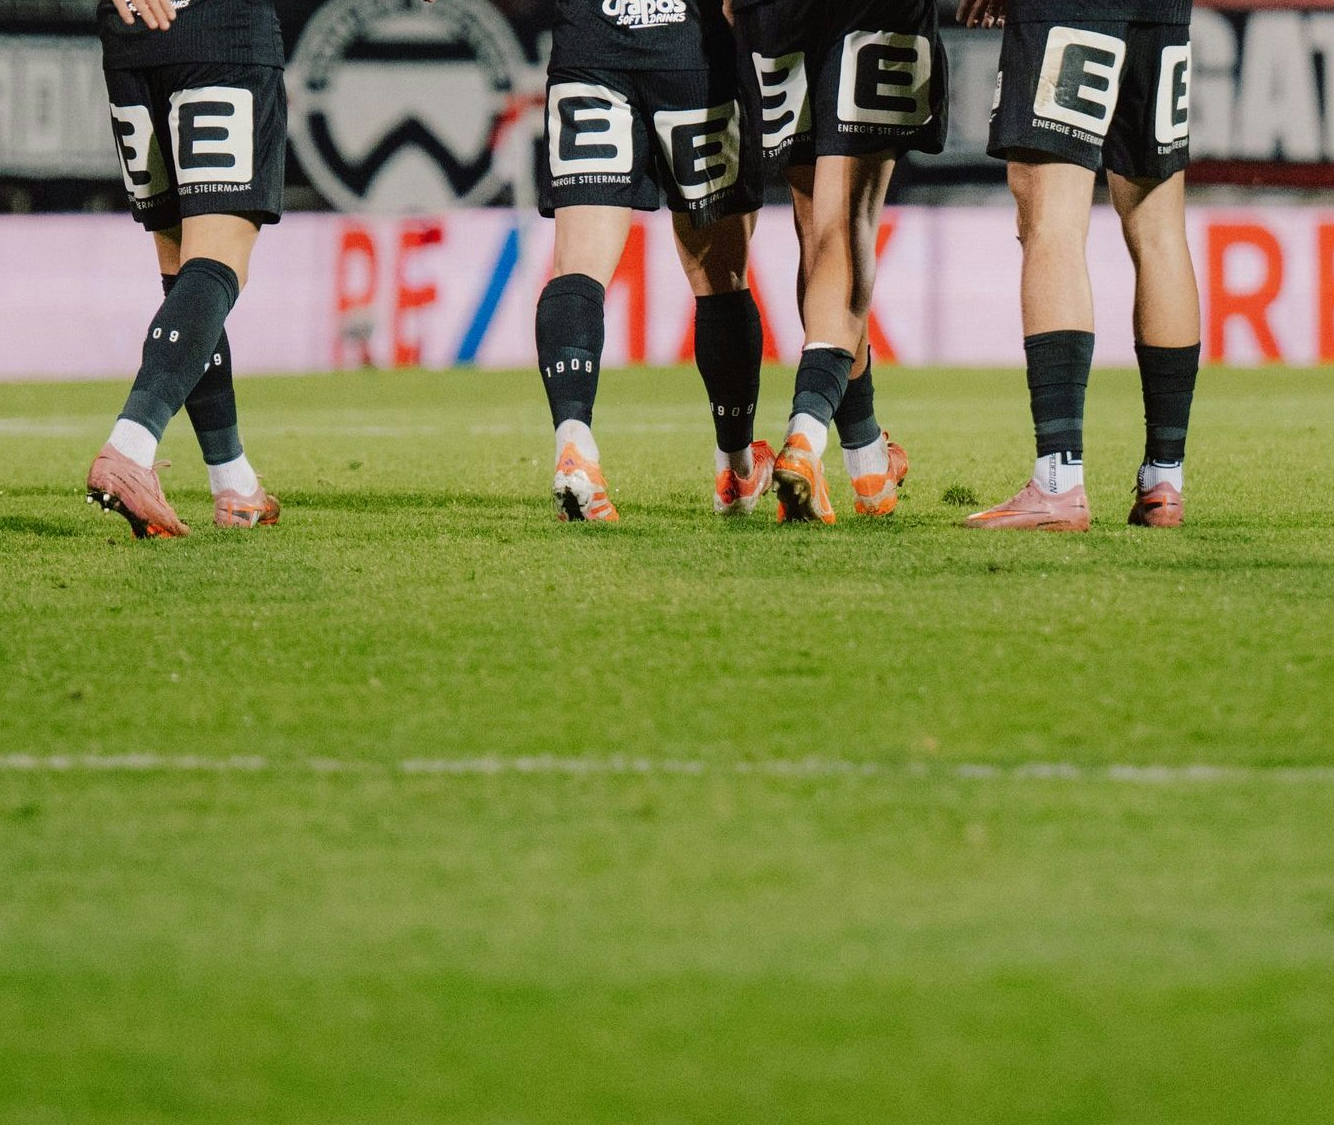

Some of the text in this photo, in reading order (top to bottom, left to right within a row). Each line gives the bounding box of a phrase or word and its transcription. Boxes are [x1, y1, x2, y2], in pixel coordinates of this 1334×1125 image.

[616, 13, 686, 25] SOFT DRINKS
[1032, 118, 1069, 135] ENERGIE
[579, 176, 632, 185] STEIERMARK
[194, 183, 252, 194] STEIERMARK
[546, 358, 593, 378] 1909
[710, 402, 754, 418] 1909
